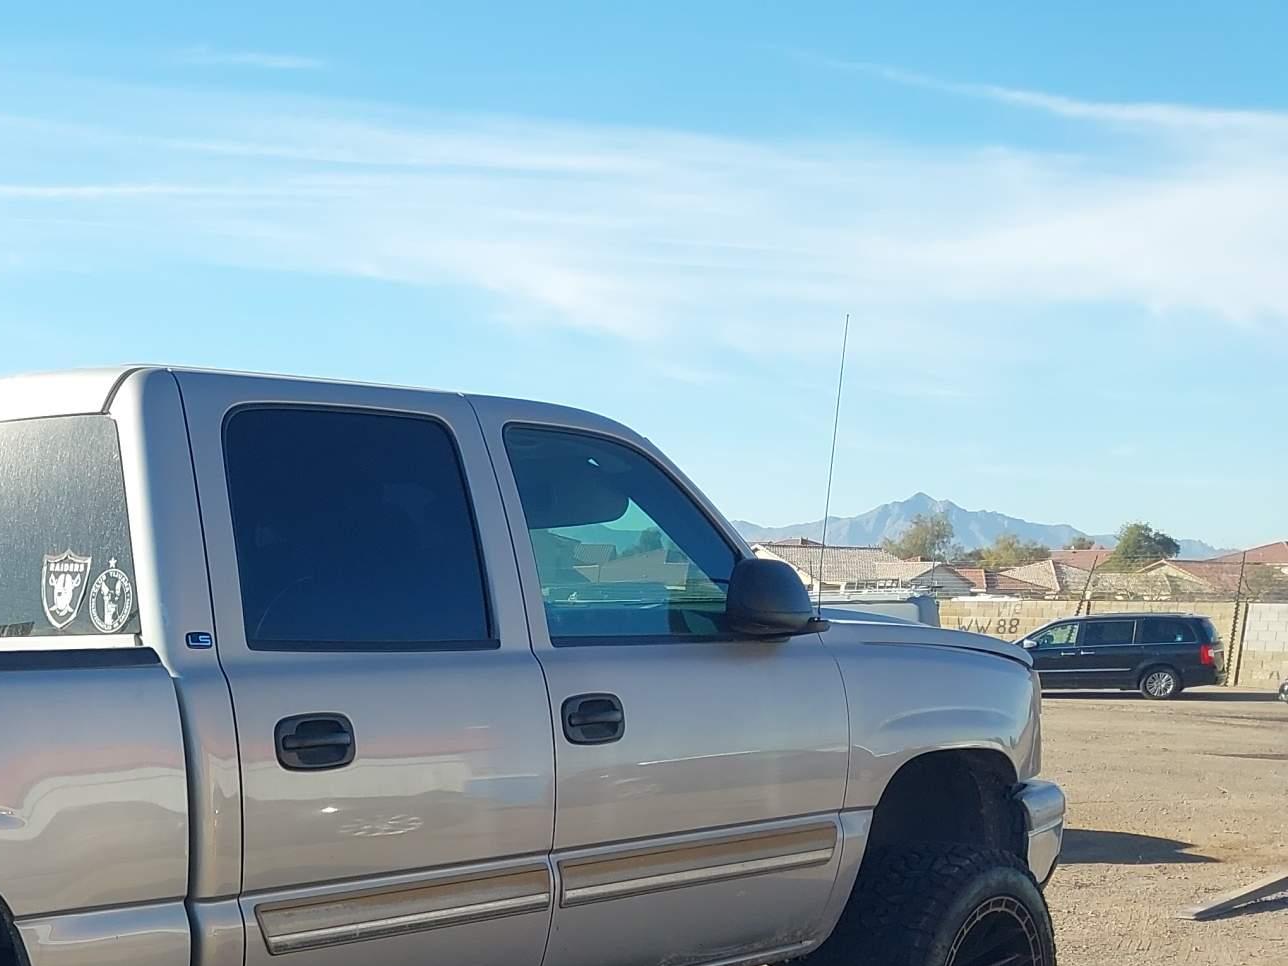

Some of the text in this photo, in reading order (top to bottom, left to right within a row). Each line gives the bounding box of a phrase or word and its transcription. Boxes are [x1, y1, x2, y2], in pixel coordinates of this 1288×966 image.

[49, 562, 85, 573] RAIDERS
[996, 618, 1020, 634] 88
[188, 634, 211, 646] LS
